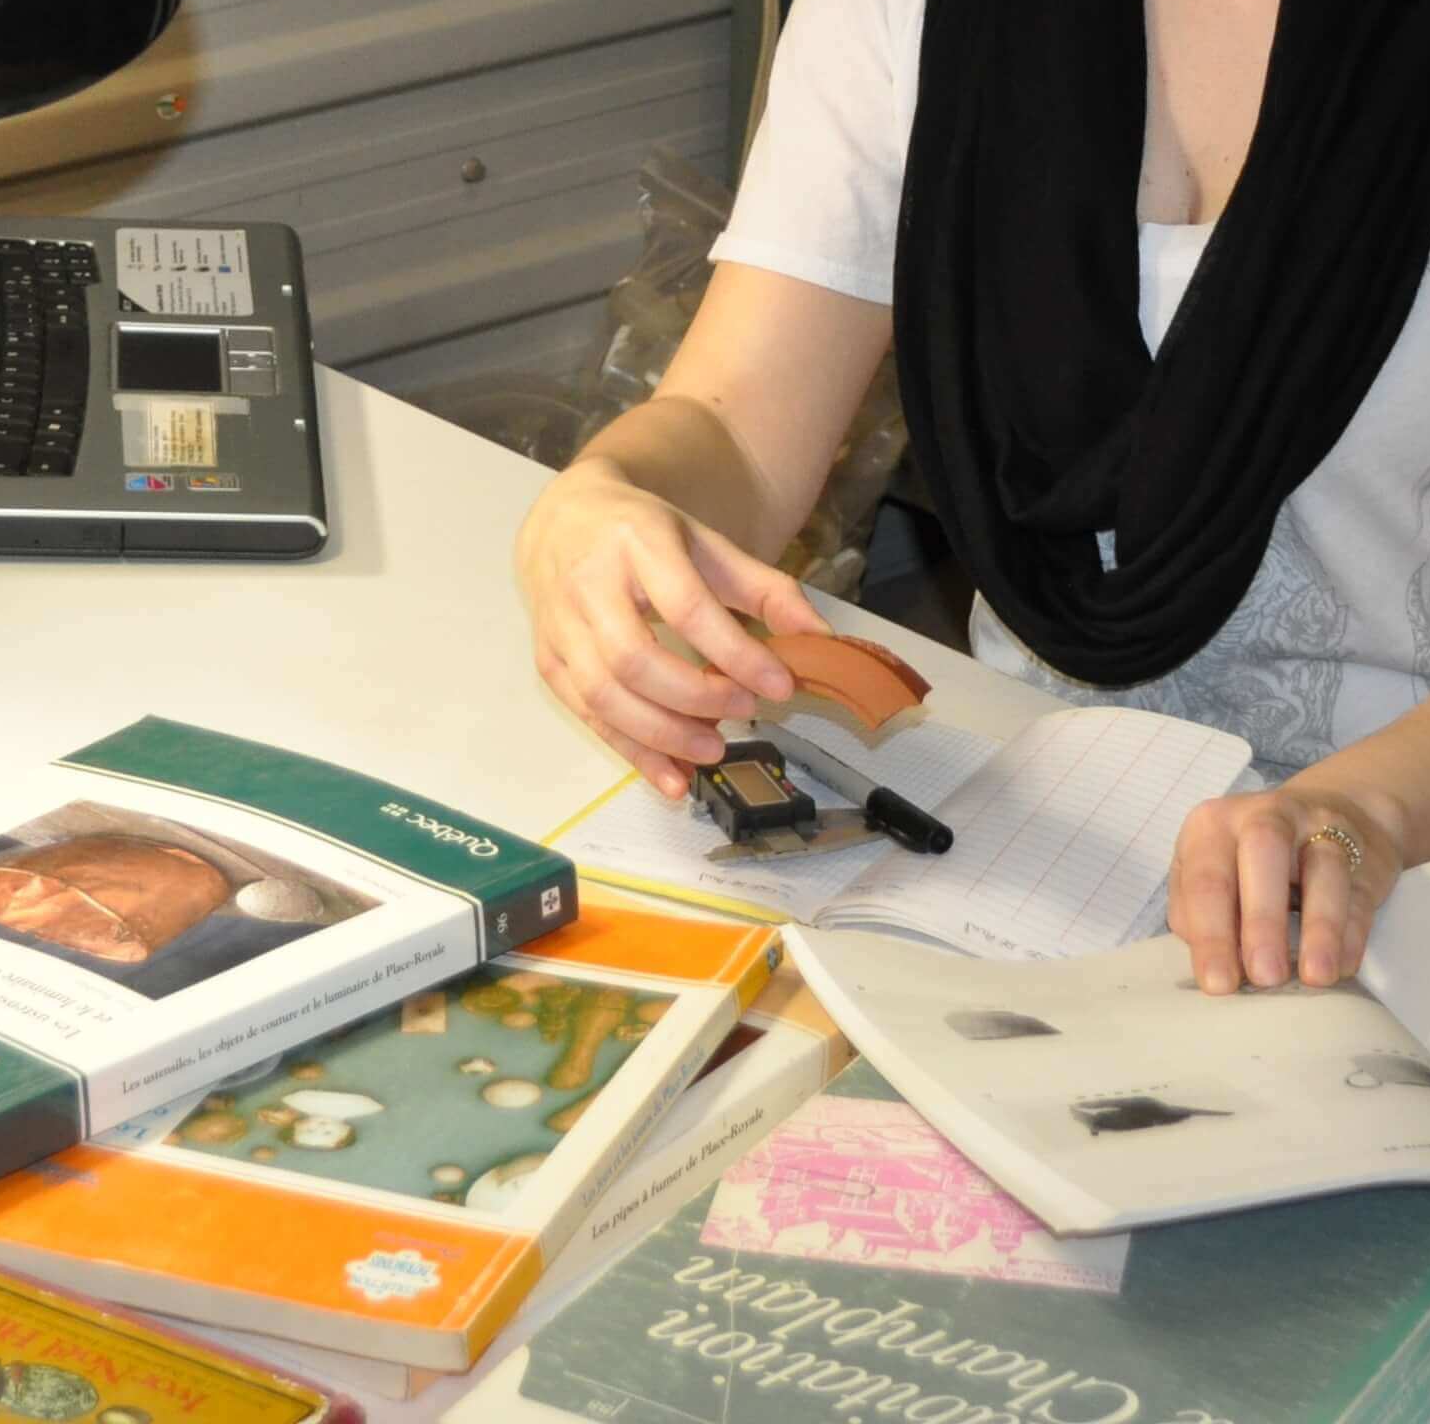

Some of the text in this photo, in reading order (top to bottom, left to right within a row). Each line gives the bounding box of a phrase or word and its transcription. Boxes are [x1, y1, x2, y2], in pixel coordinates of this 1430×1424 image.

[405, 810, 500, 860] Québec
[120, 1079, 141, 1097] Les
[197, 1042, 213, 1065] les
[214, 1030, 245, 1060] objets
[246, 1023, 260, 1043] de
[261, 1008, 300, 1036] couture
[302, 1002, 311, 1016] et
[312, 995, 323, 1013] le
[324, 976, 371, 1007] luminaire
[372, 968, 384, 985] de
[591, 1107, 765, 1240] Les pipes à fumer de Place-Royale
[673, 1253, 1139, 1424] Champlain
